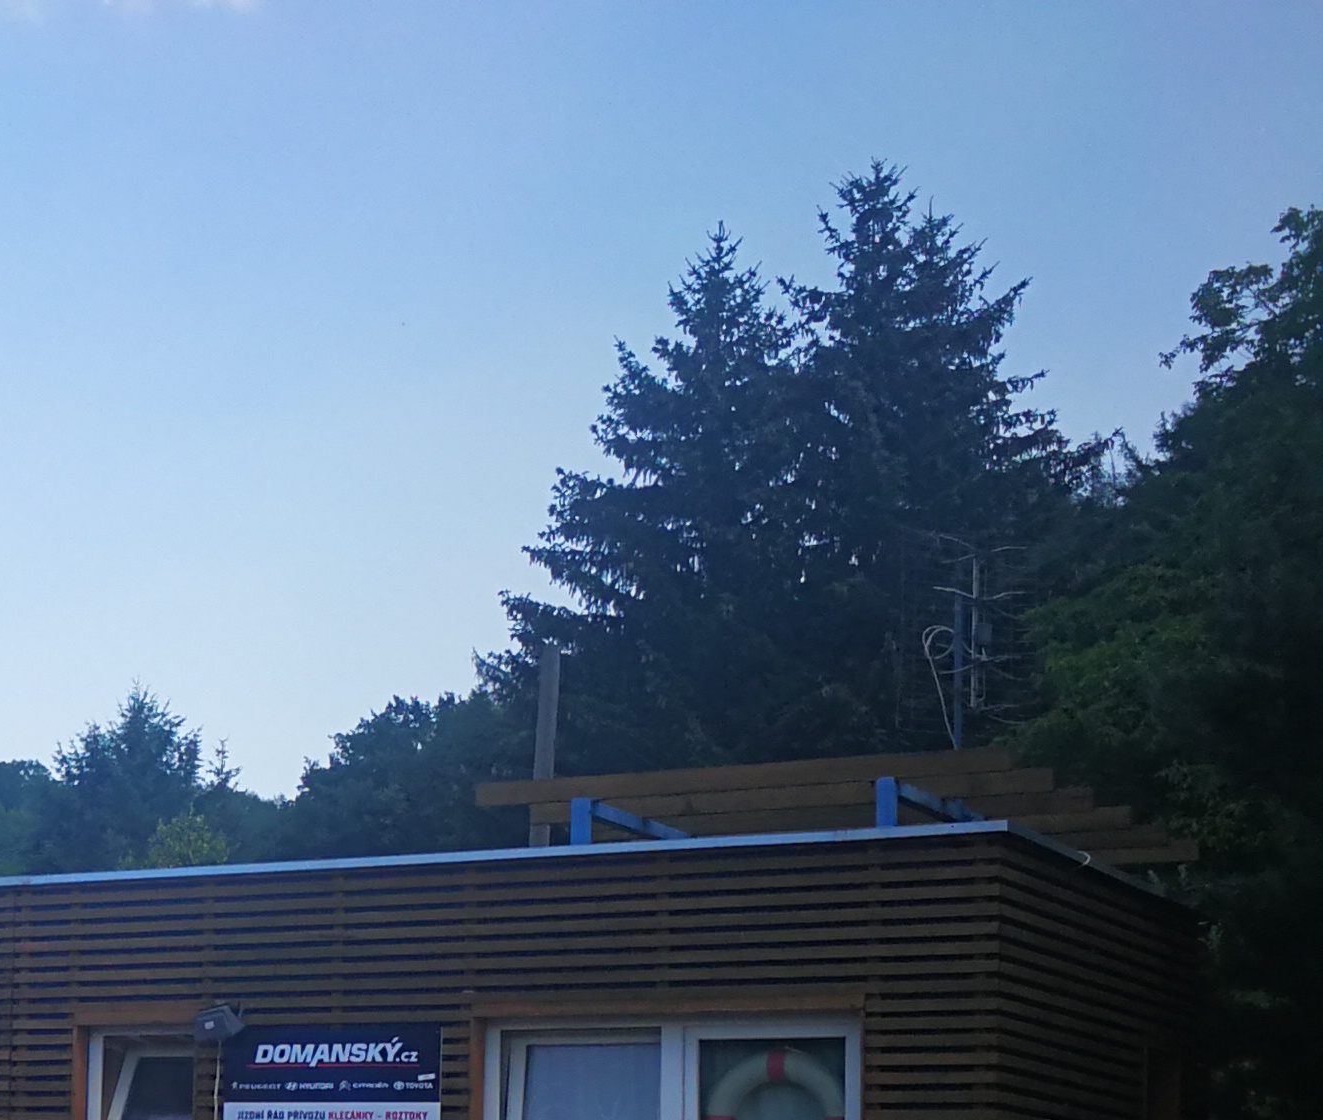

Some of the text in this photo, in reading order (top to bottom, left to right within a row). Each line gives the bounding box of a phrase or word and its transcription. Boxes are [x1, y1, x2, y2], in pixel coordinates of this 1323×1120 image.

[404, 1081, 434, 1091] TOYOTA
[237, 1109, 265, 1120] JÍZDNÍ
[266, 1108, 285, 1120] ŘÁD
[287, 1108, 326, 1120] PŘÍVOZU
